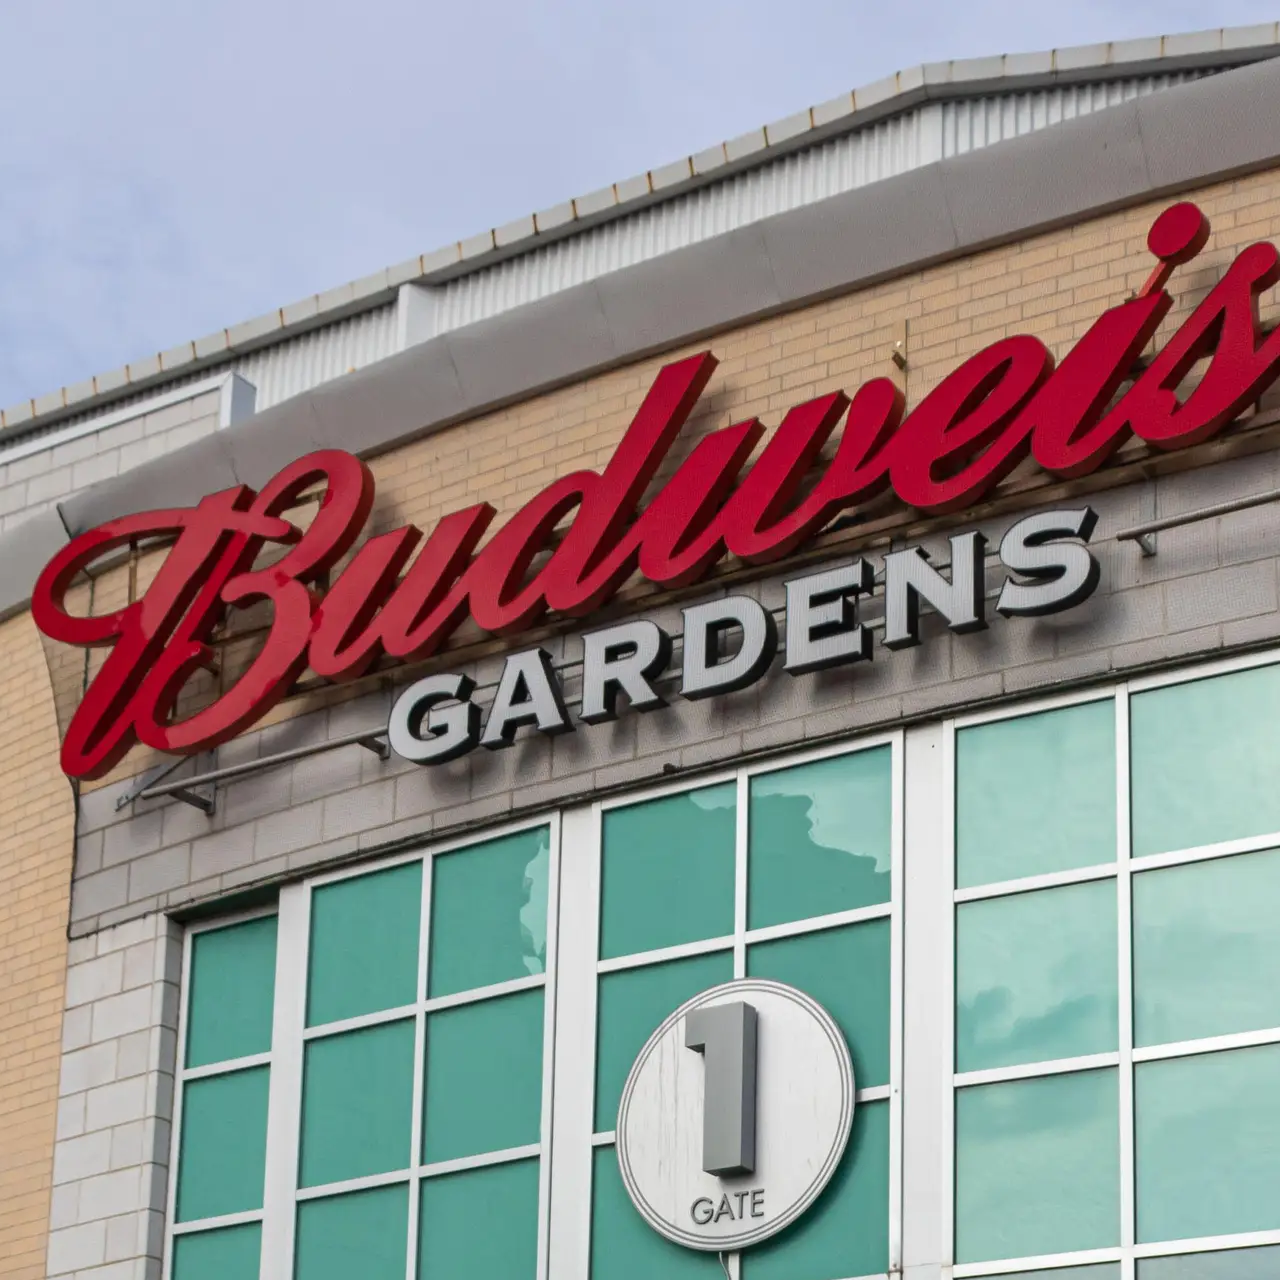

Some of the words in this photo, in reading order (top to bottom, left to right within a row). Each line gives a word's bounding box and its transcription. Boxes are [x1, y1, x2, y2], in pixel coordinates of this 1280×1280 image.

[387, 505, 1101, 767] GARDENS
[685, 1001, 757, 1177] 1
[690, 1189, 765, 1225] GATE
